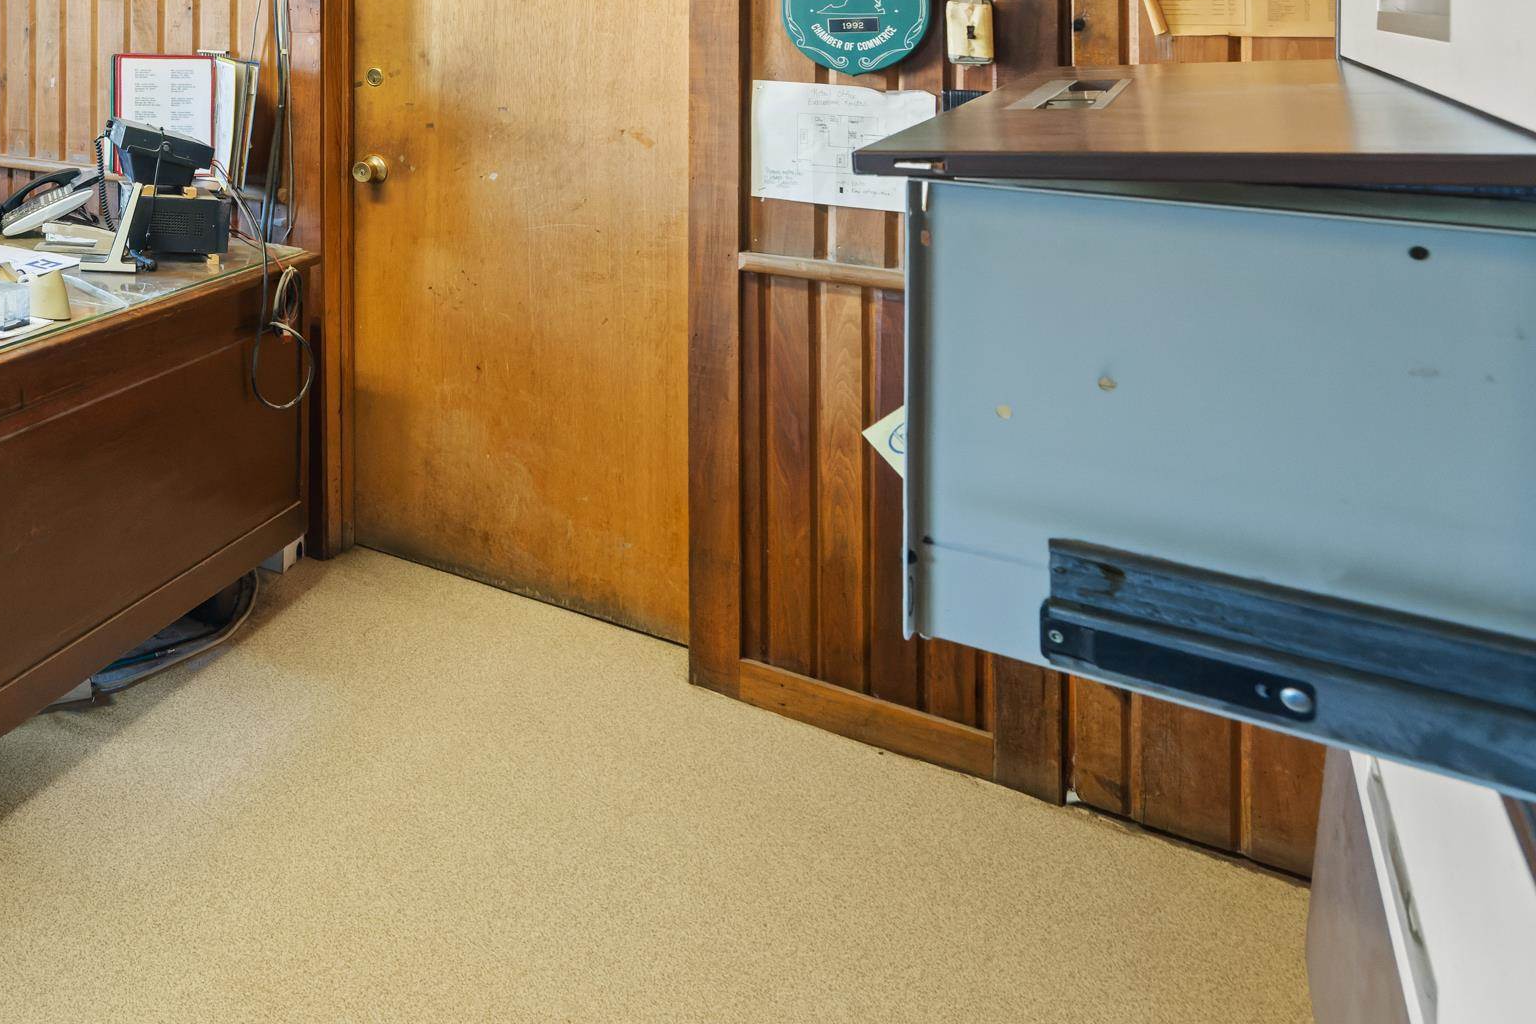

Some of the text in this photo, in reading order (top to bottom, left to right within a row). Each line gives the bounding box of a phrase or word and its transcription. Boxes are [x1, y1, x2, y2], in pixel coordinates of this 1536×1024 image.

[842, 21, 865, 30] 1992
[811, 23, 897, 51] CHAMBER OF COMMERCE
